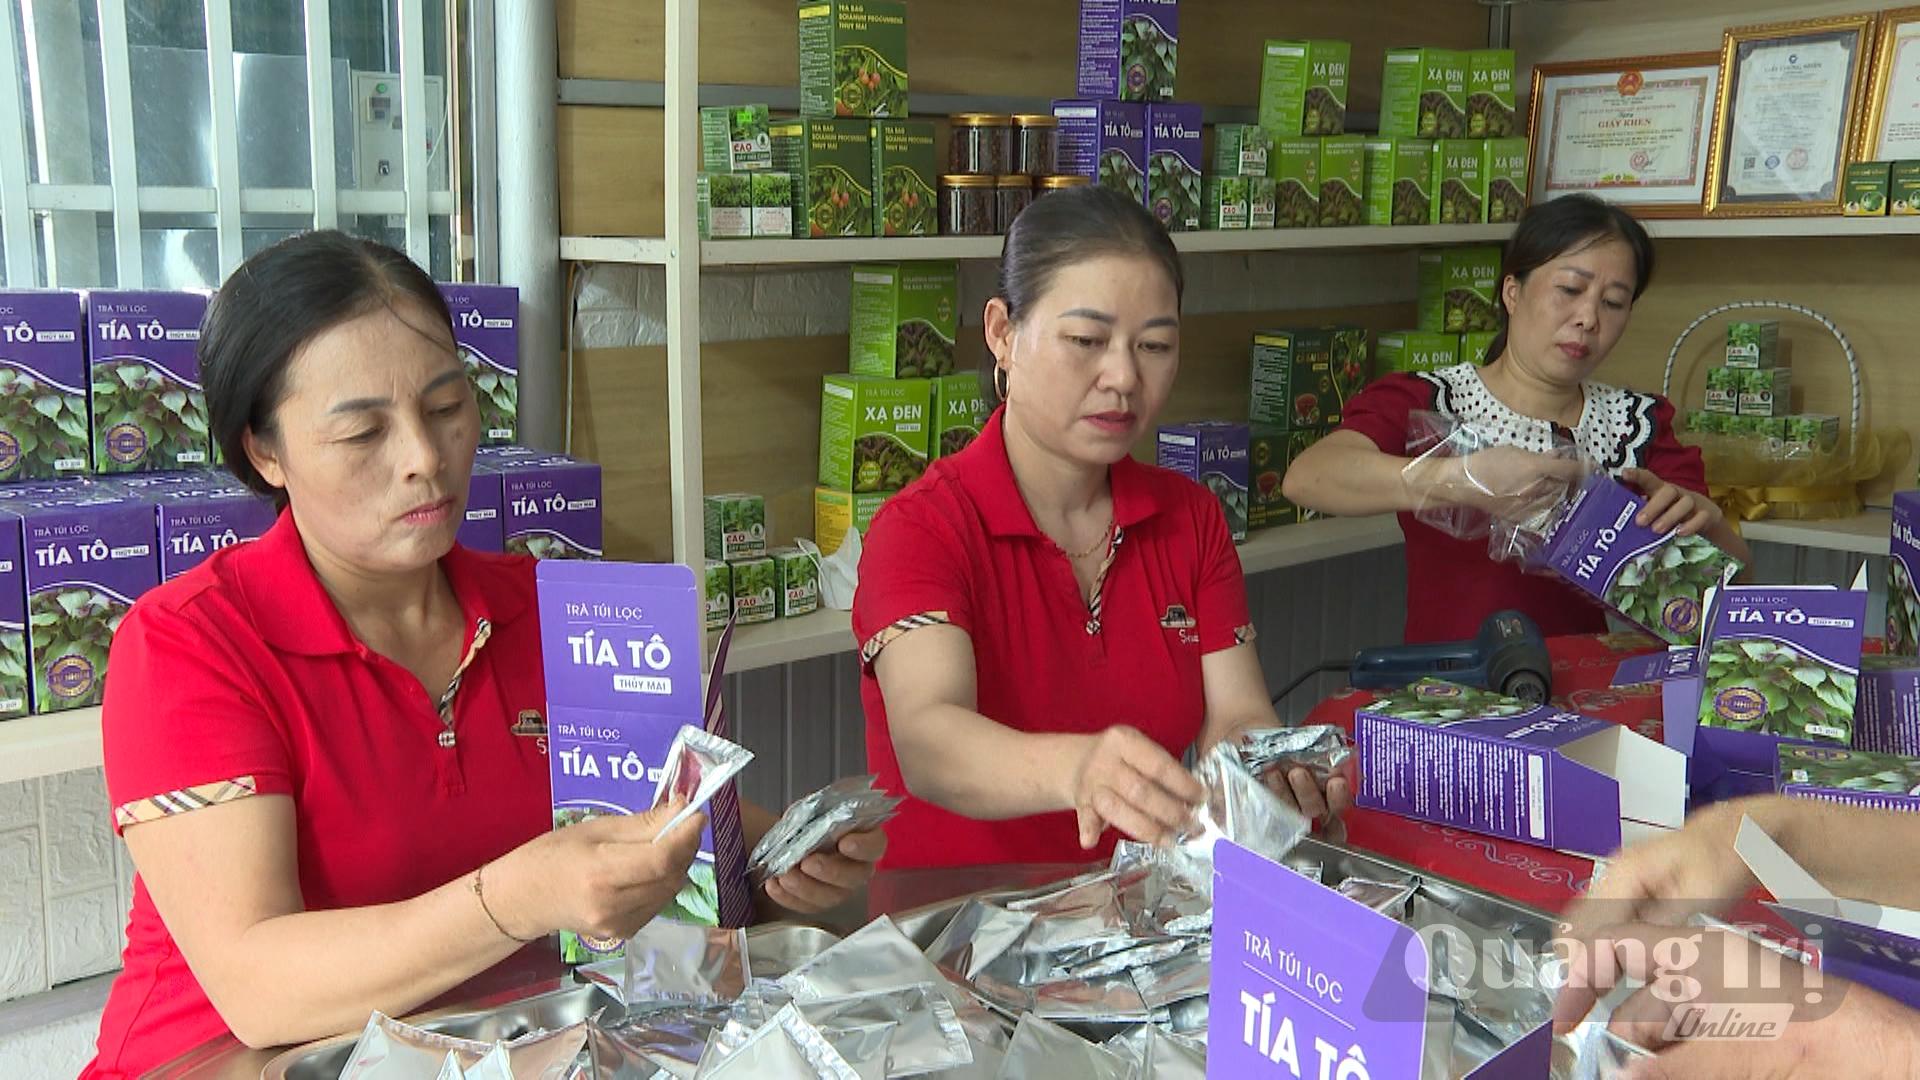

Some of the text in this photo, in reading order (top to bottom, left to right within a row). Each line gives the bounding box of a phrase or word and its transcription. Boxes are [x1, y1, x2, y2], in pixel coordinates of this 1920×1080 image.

[1105, 121, 1131, 137] TÍA TÔ
[1154, 123, 1184, 138] TÍA TÔ
[460, 309, 482, 328] TÔ
[3, 320, 34, 343] TÔ
[99, 318, 132, 340] TÍA
[138, 319, 164, 340] TÔ
[865, 405, 922, 424] XẠ ĐEN
[949, 400, 967, 418] XẠ
[512, 496, 539, 516] TÍA
[544, 493, 566, 512] TÔ
[69, 524, 89, 536] LỌC
[171, 529, 238, 555] TÍA TÔ
[35, 543, 72, 566] TÍA
[78, 539, 109, 561] TÔ
[1576, 551, 1603, 580] TÍA
[1595, 528, 1617, 552] TÔ
[566, 602, 642, 621] TRÀ TÚI LỌC
[1728, 607, 1764, 622] TÍA
[1773, 608, 1806, 624] TÔ
[567, 629, 671, 670] TÍA TÔ
[647, 679, 667, 692] MAI
[559, 724, 620, 740] TRÀ TÚI LỌC
[559, 746, 601, 778] TÍA
[608, 751, 644, 781] TÔ
[1244, 930, 1344, 1005] TRÀ TÚI LỌC
[1240, 988, 1370, 1080] TÍA TÔ
